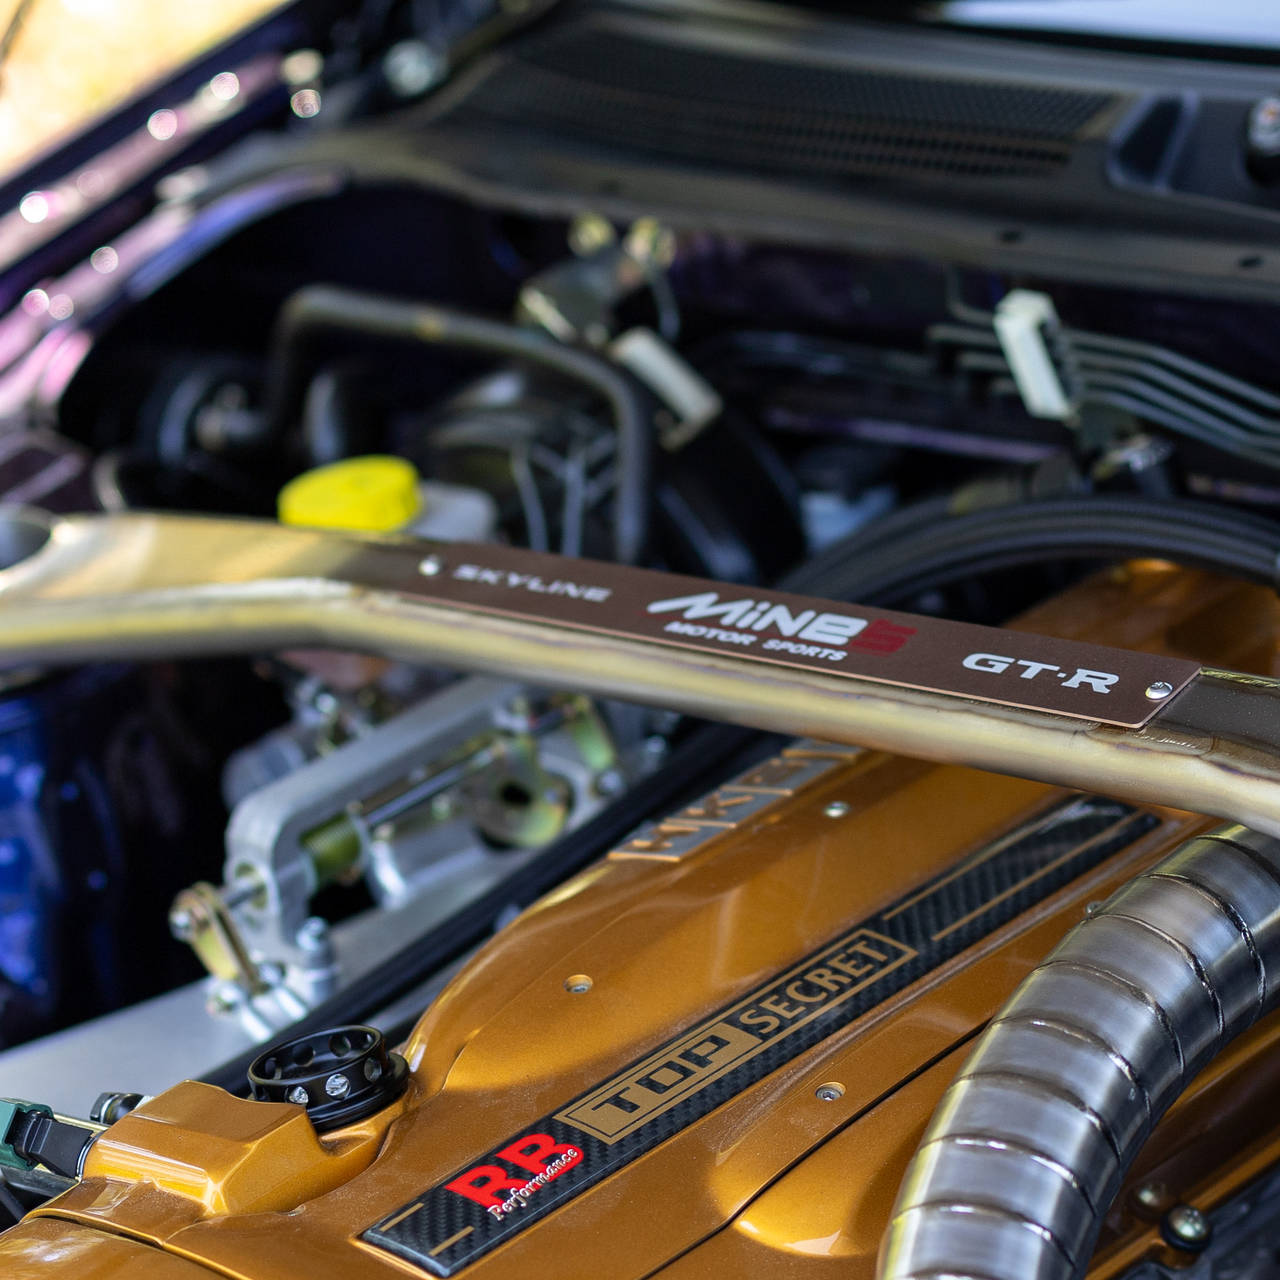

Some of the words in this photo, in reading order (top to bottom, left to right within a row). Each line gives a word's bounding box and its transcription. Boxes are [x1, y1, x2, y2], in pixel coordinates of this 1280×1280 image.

[453, 563, 613, 602] SKYLINE
[664, 621, 757, 646] MOTOR
[762, 638, 848, 661] SPORTS
[592, 1034, 731, 1114] TOP
[739, 941, 889, 1034] SECRET
[444, 1133, 585, 1211] RB
[487, 1148, 578, 1221] Performance
